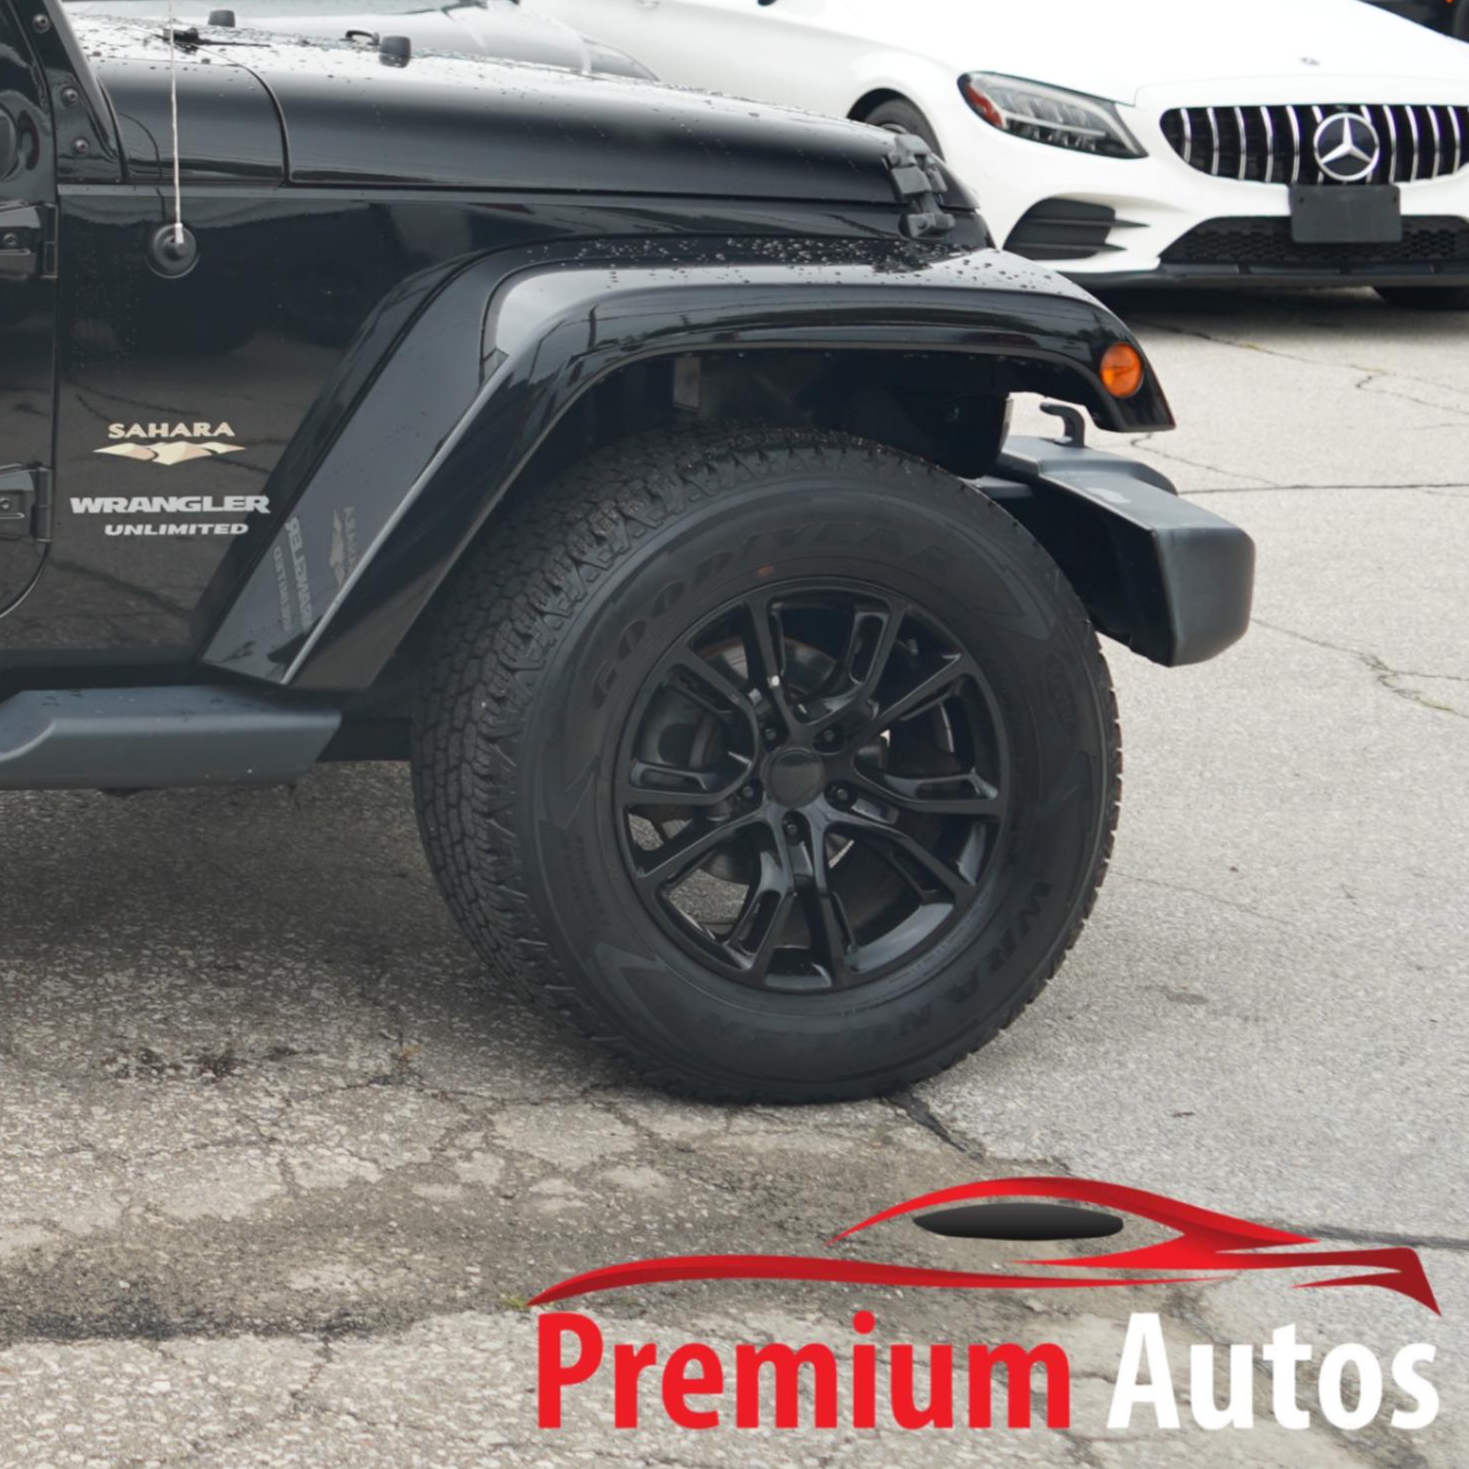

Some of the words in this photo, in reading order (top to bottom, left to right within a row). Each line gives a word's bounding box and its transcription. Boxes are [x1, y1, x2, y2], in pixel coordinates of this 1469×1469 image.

[108, 421, 236, 439] SAHARA
[69, 494, 271, 514] WRANGLER
[104, 523, 249, 536] UNLIMITED
